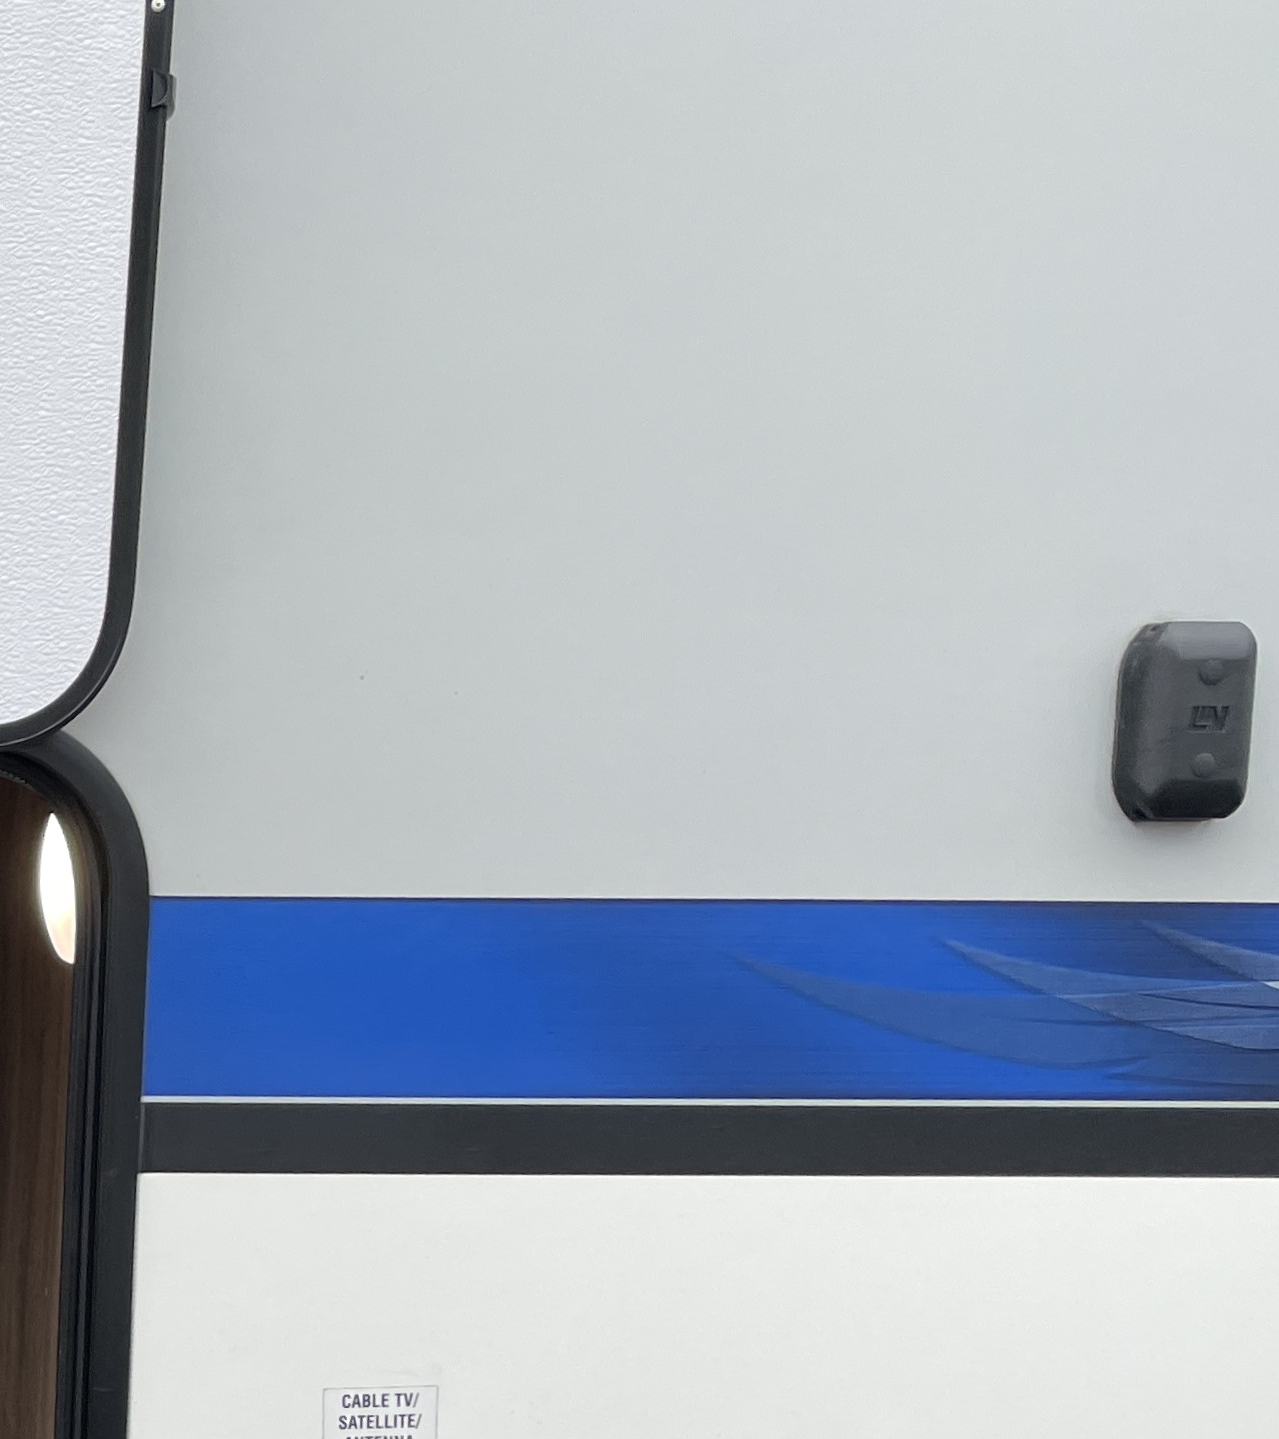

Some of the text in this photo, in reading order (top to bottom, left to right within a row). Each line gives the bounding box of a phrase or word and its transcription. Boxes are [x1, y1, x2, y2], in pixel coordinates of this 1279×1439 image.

[341, 1392, 420, 1409] CABLE TV/
[338, 1413, 423, 1430] SATELLITE/
